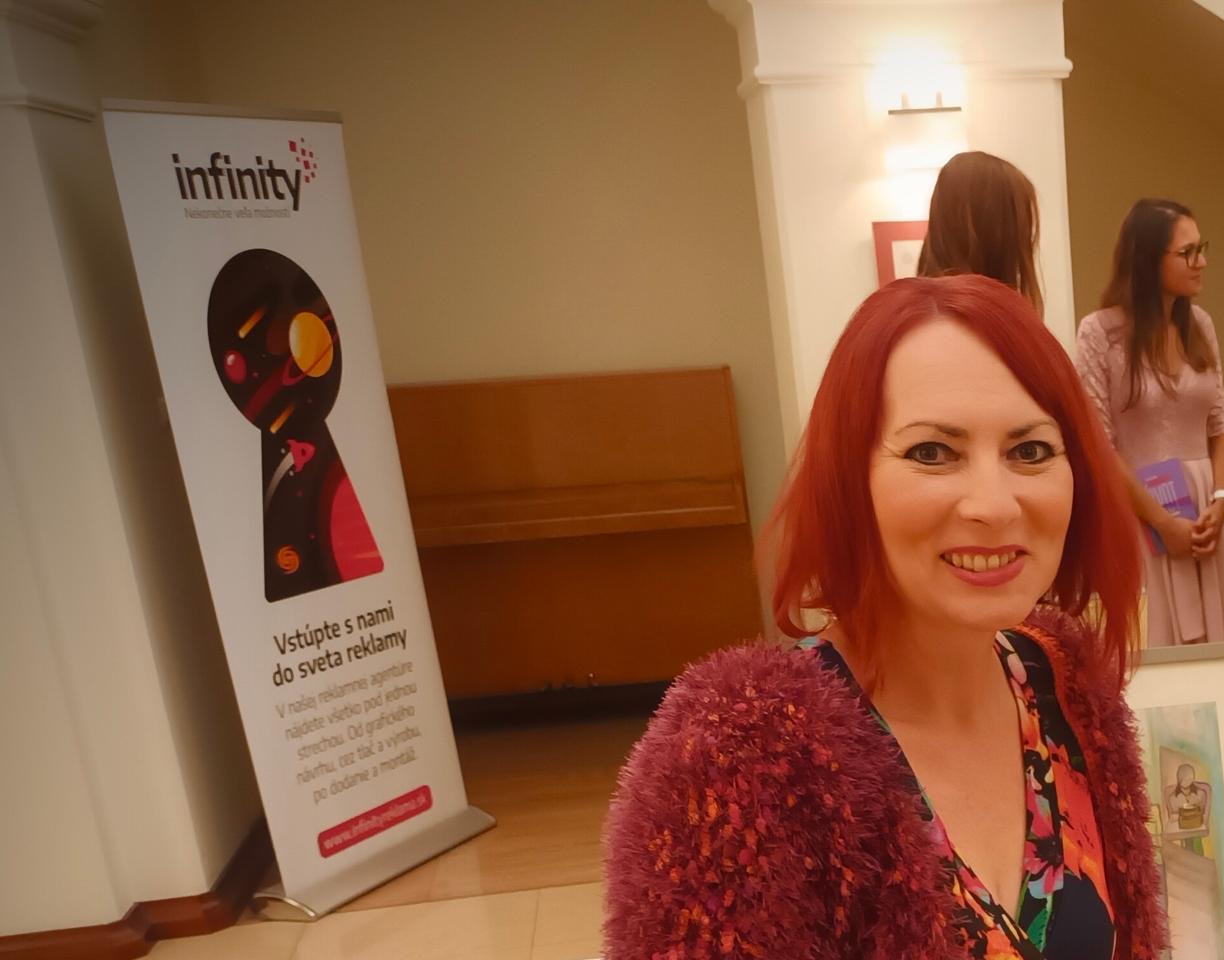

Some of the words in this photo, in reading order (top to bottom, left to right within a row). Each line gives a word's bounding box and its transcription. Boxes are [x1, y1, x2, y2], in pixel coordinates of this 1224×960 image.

[171, 152, 302, 212] infinity
[273, 620, 341, 655] Vstúpte
[344, 618, 354, 635] s
[356, 600, 395, 631] nami
[272, 662, 295, 687] do
[298, 649, 343, 679] sveta
[346, 628, 407, 663] reklamy
[313, 787, 328, 806] po
